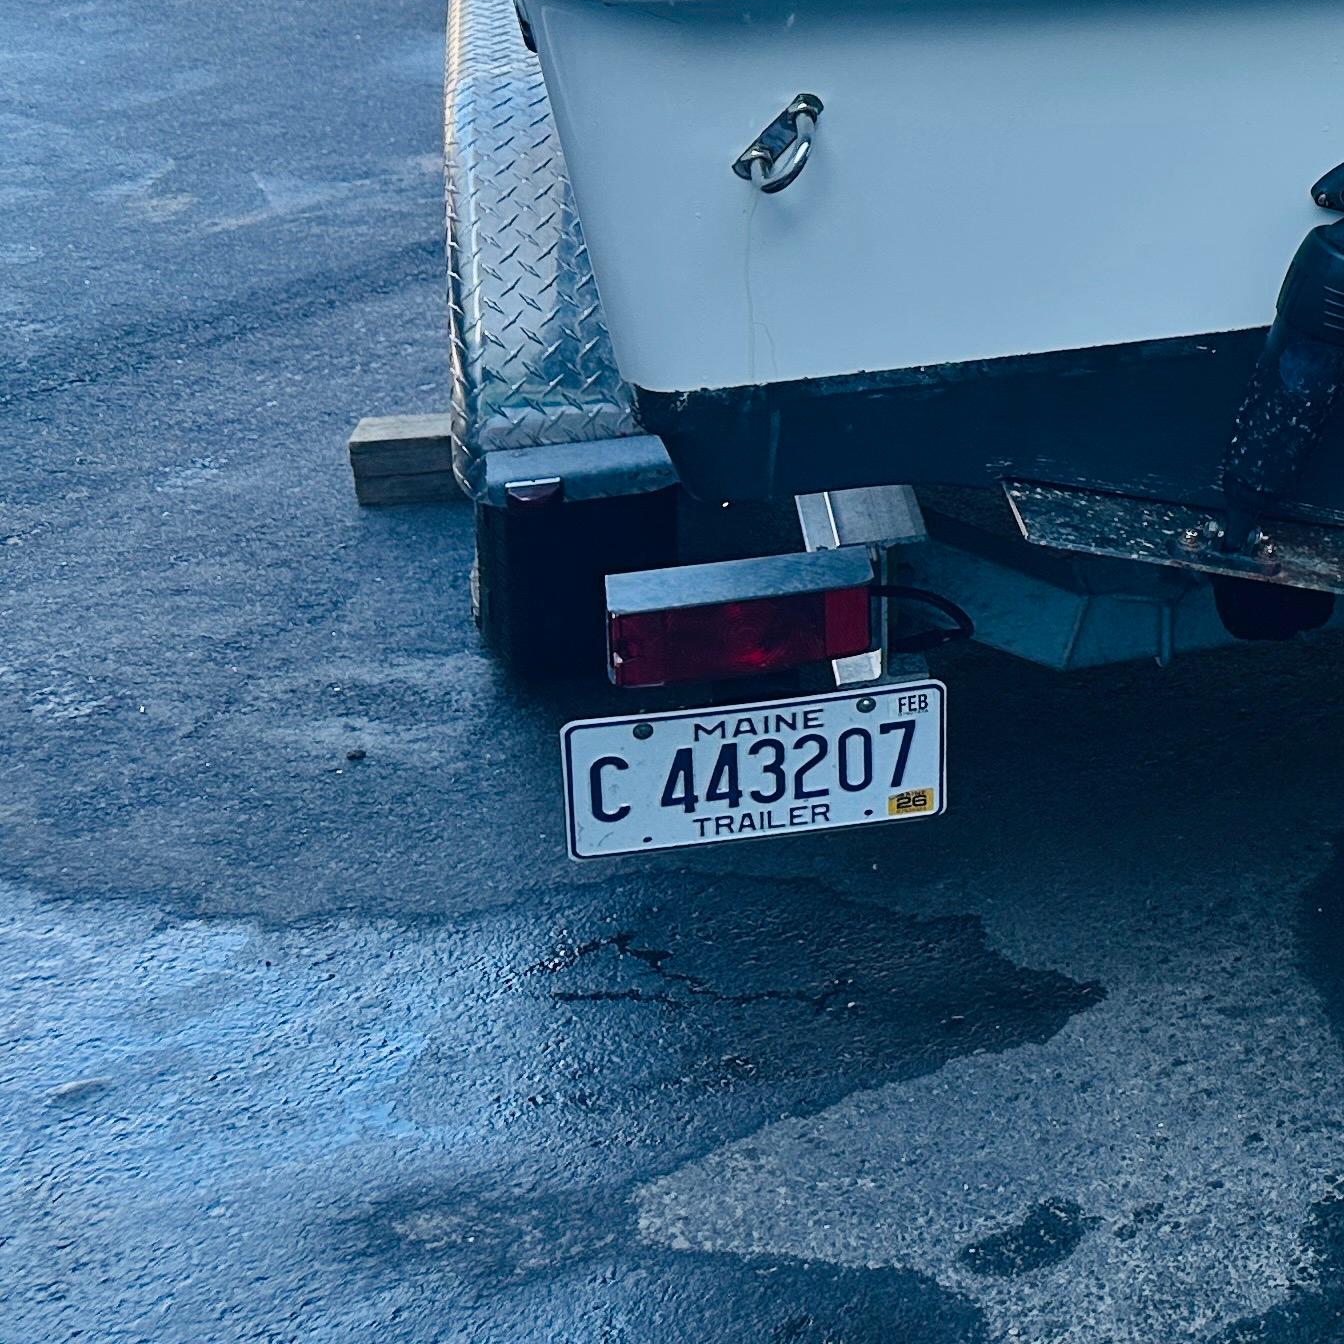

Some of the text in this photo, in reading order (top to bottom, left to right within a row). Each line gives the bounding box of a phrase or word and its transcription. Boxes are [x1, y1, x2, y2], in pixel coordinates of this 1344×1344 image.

[898, 693, 928, 713] FEB
[693, 708, 825, 742] MAINE
[589, 719, 916, 822] C 443207
[896, 794, 927, 809] 26
[692, 803, 830, 837] TRAILER
